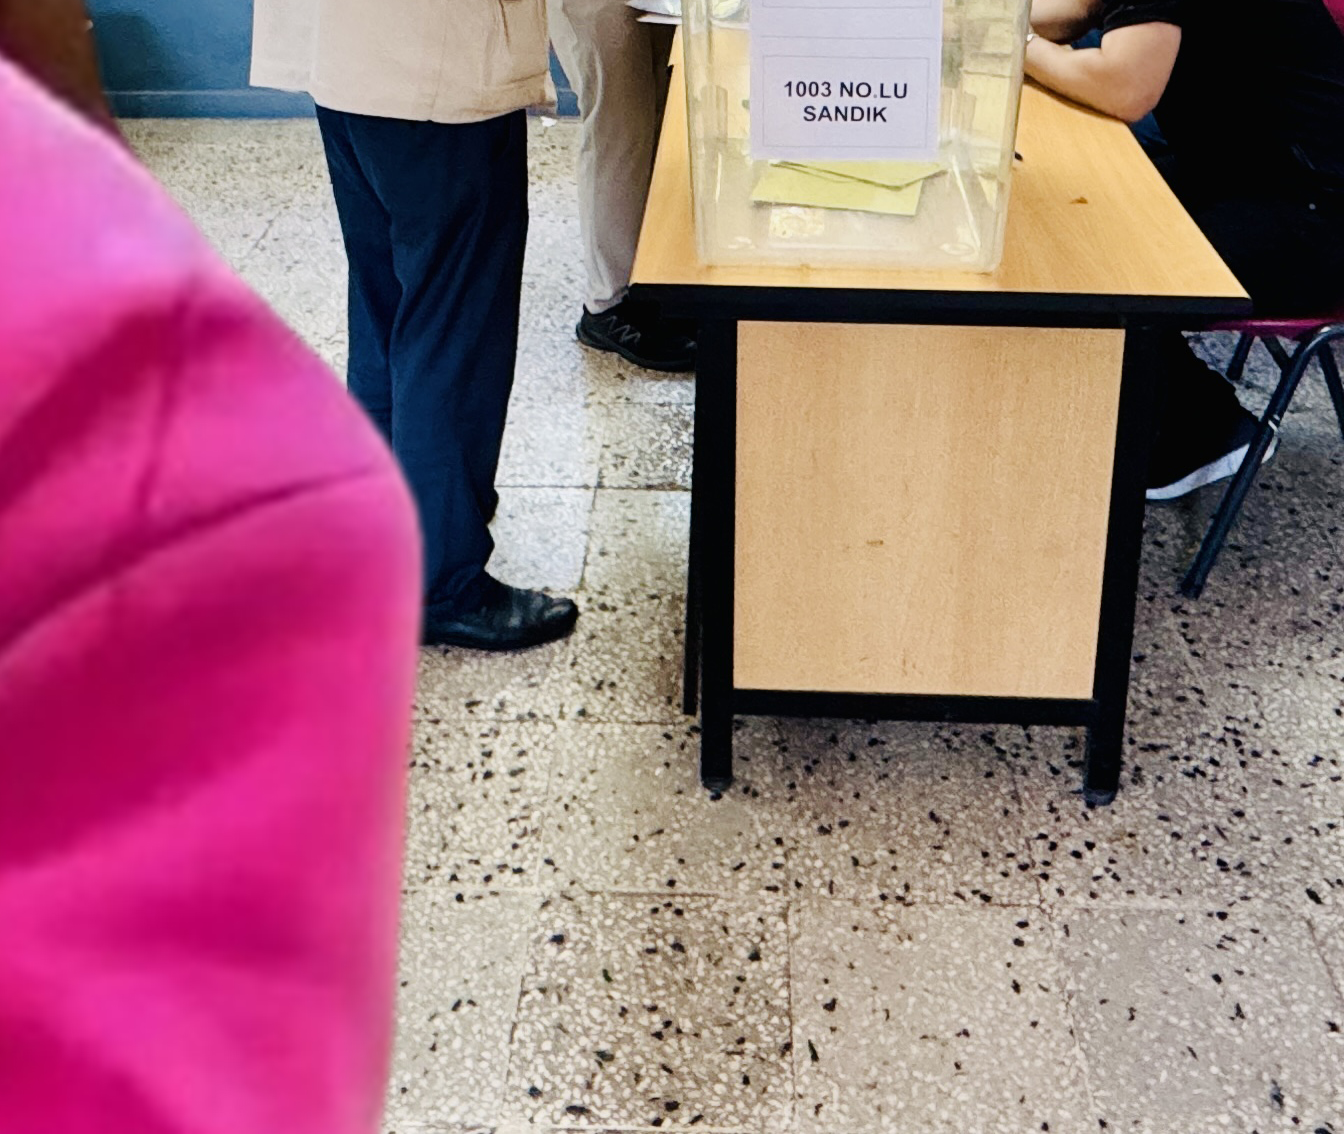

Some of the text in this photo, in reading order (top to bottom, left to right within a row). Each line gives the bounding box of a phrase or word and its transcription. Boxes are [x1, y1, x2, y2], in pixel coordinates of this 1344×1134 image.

[784, 81, 909, 99] 1003 NO.LU
[803, 106, 888, 123] SANDIK
